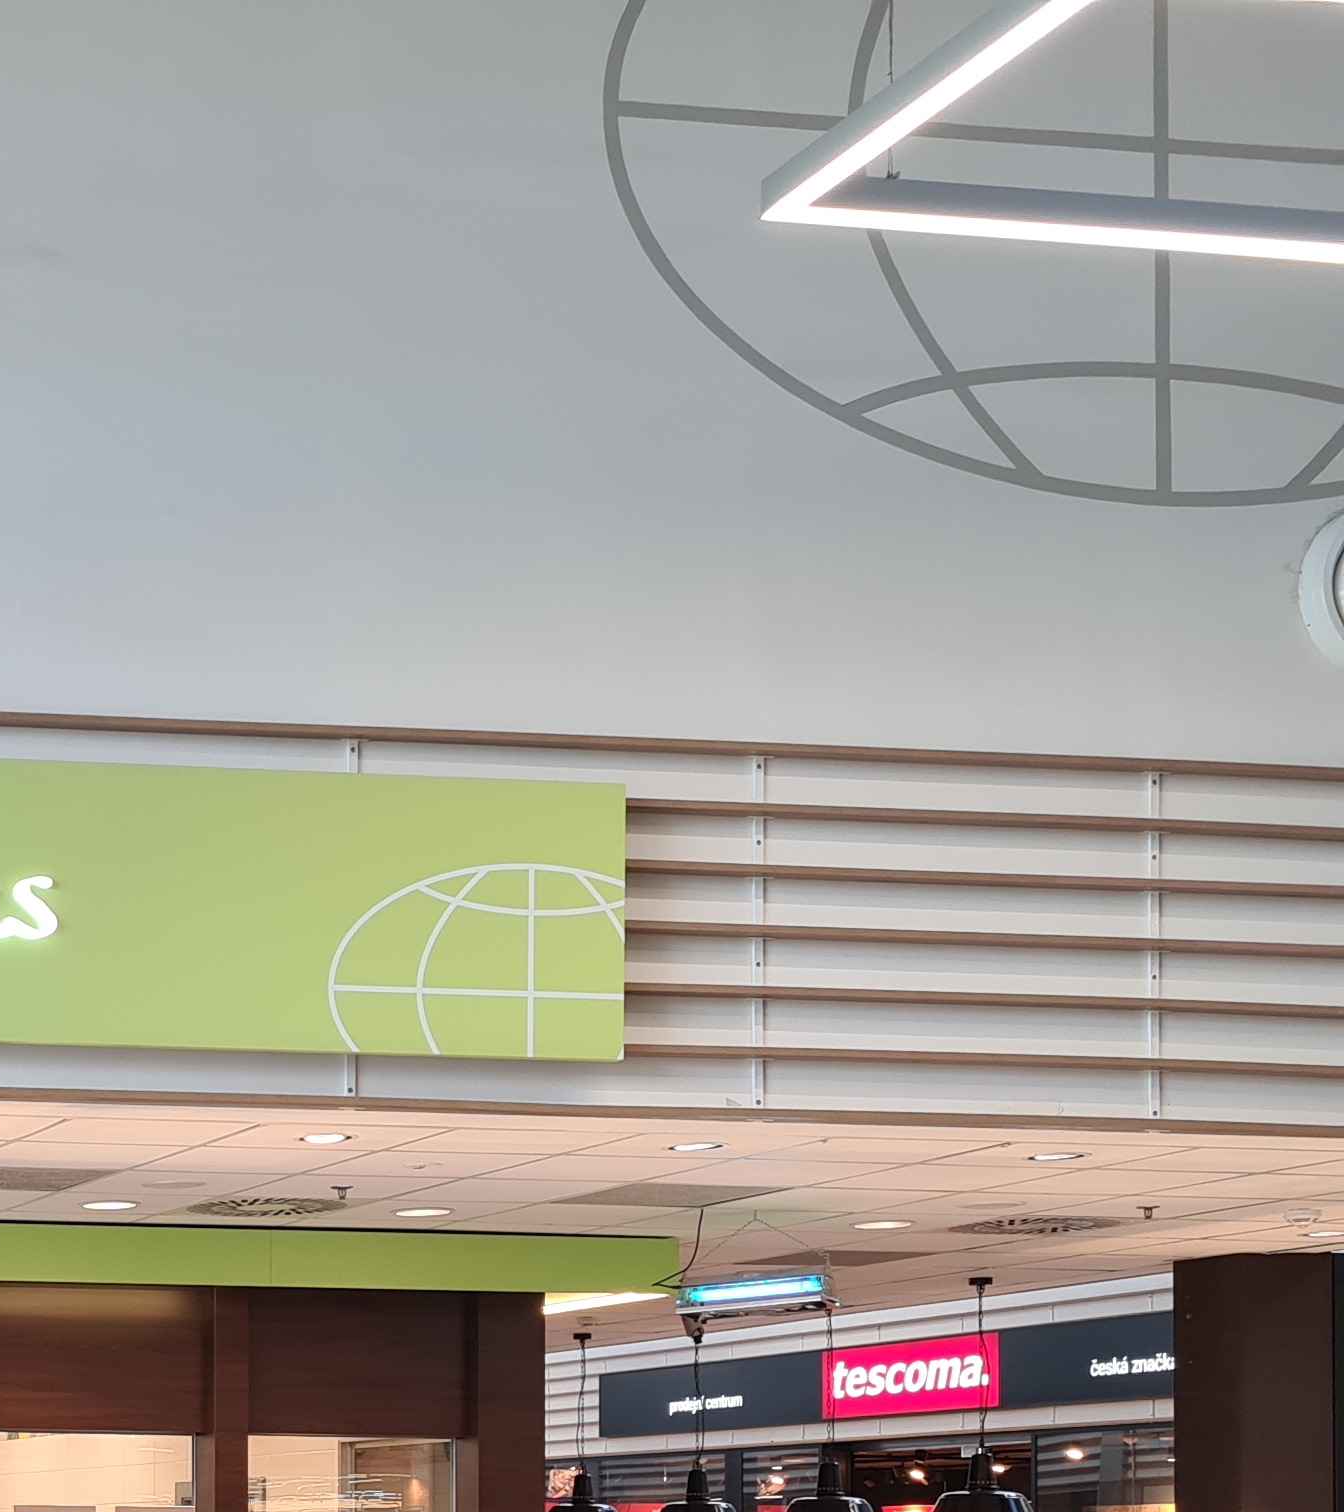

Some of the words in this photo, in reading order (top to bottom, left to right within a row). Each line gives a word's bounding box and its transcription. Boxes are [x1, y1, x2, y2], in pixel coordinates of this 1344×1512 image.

[1089, 1356, 1130, 1377] česká
[668, 1395, 705, 1417] prodejní
[705, 1394, 744, 1410] centrum
